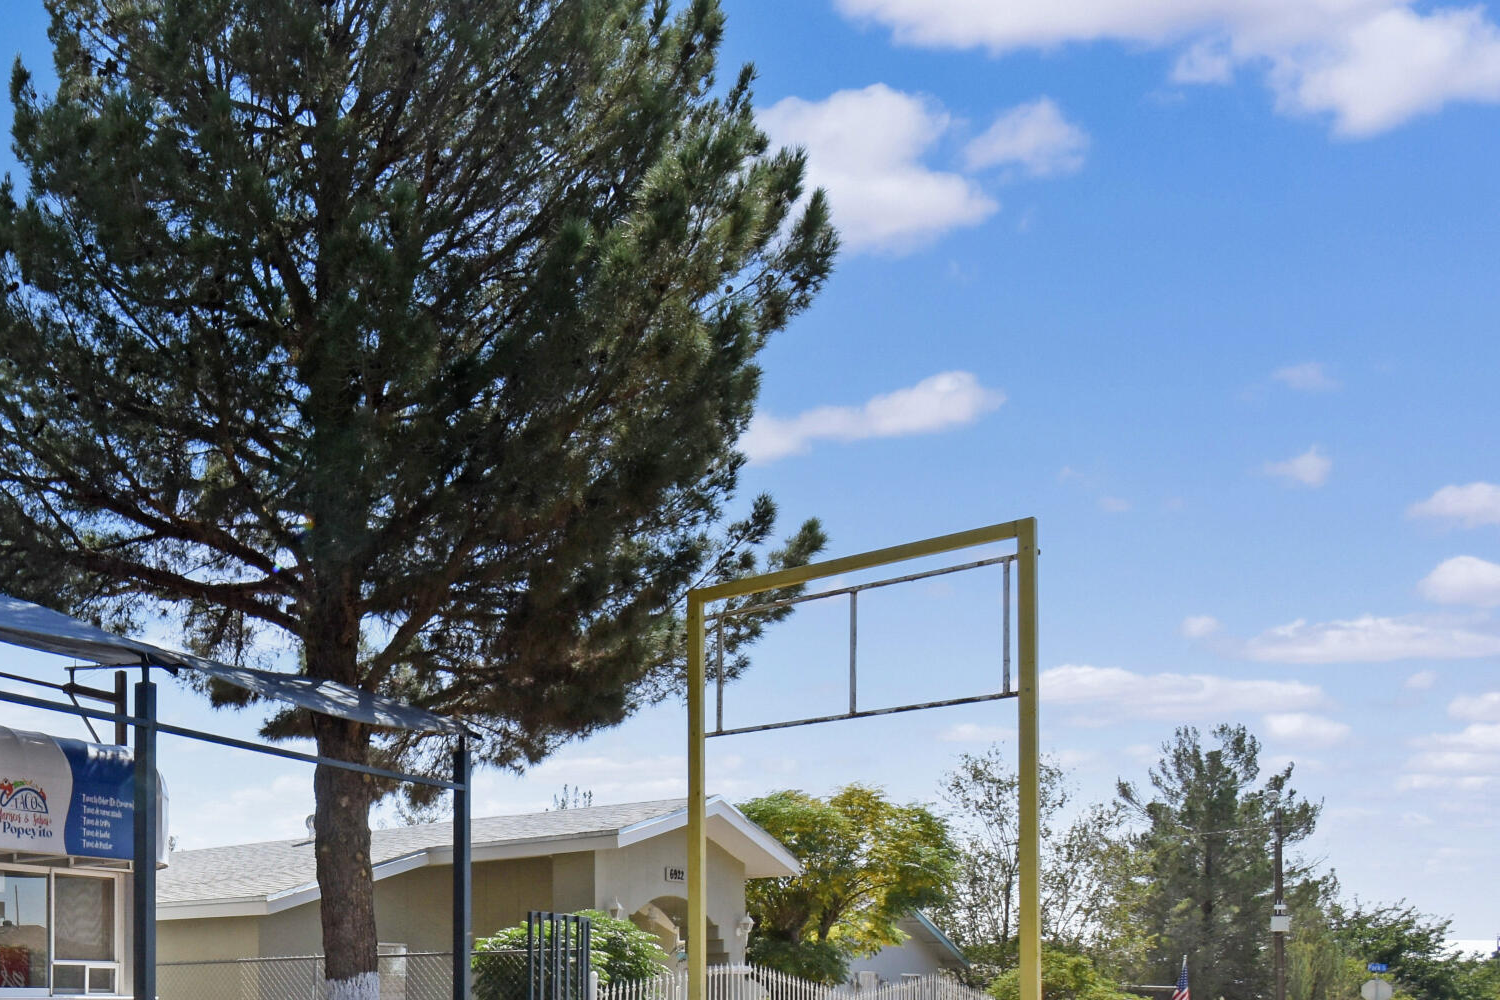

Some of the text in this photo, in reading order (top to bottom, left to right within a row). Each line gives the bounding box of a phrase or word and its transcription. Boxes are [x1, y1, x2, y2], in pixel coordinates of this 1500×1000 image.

[14, 792, 43, 811] TACOS
[24, 813, 29, 823] &
[3, 821, 53, 839] Popeyito
[669, 868, 684, 880] 6922
